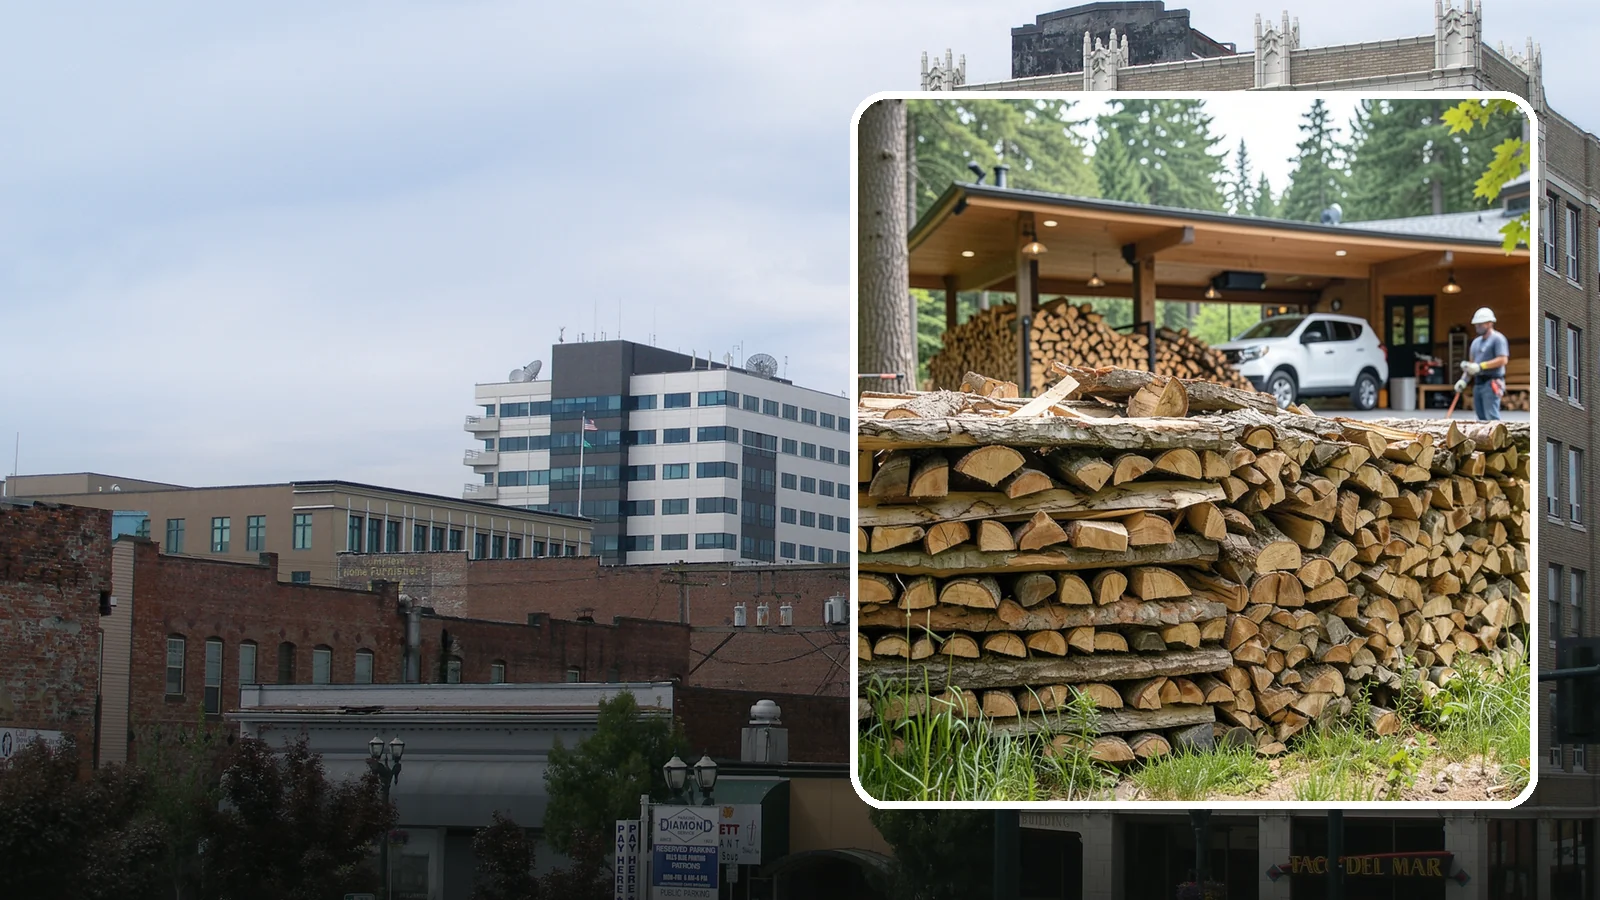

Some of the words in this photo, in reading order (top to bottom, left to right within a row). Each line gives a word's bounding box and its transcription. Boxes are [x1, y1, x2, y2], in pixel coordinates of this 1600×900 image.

[343, 567, 368, 577] Home
[370, 565, 427, 576] Furnishers
[660, 818, 713, 833] DIAMOND
[1021, 815, 1070, 828] BUILDING
[617, 825, 625, 853] PAY
[628, 824, 637, 853] PAY
[656, 845, 688, 853] RESERVED
[690, 846, 716, 854] PARKING
[721, 851, 739, 862] Soup
[671, 862, 701, 870] PATRONS
[1346, 856, 1385, 875] DEL
[1392, 857, 1443, 877] MAR
[616, 856, 625, 894] HERE
[627, 855, 636, 894] HERE
[660, 888, 682, 897] PUBLIC
[684, 889, 710, 898] PARKING
